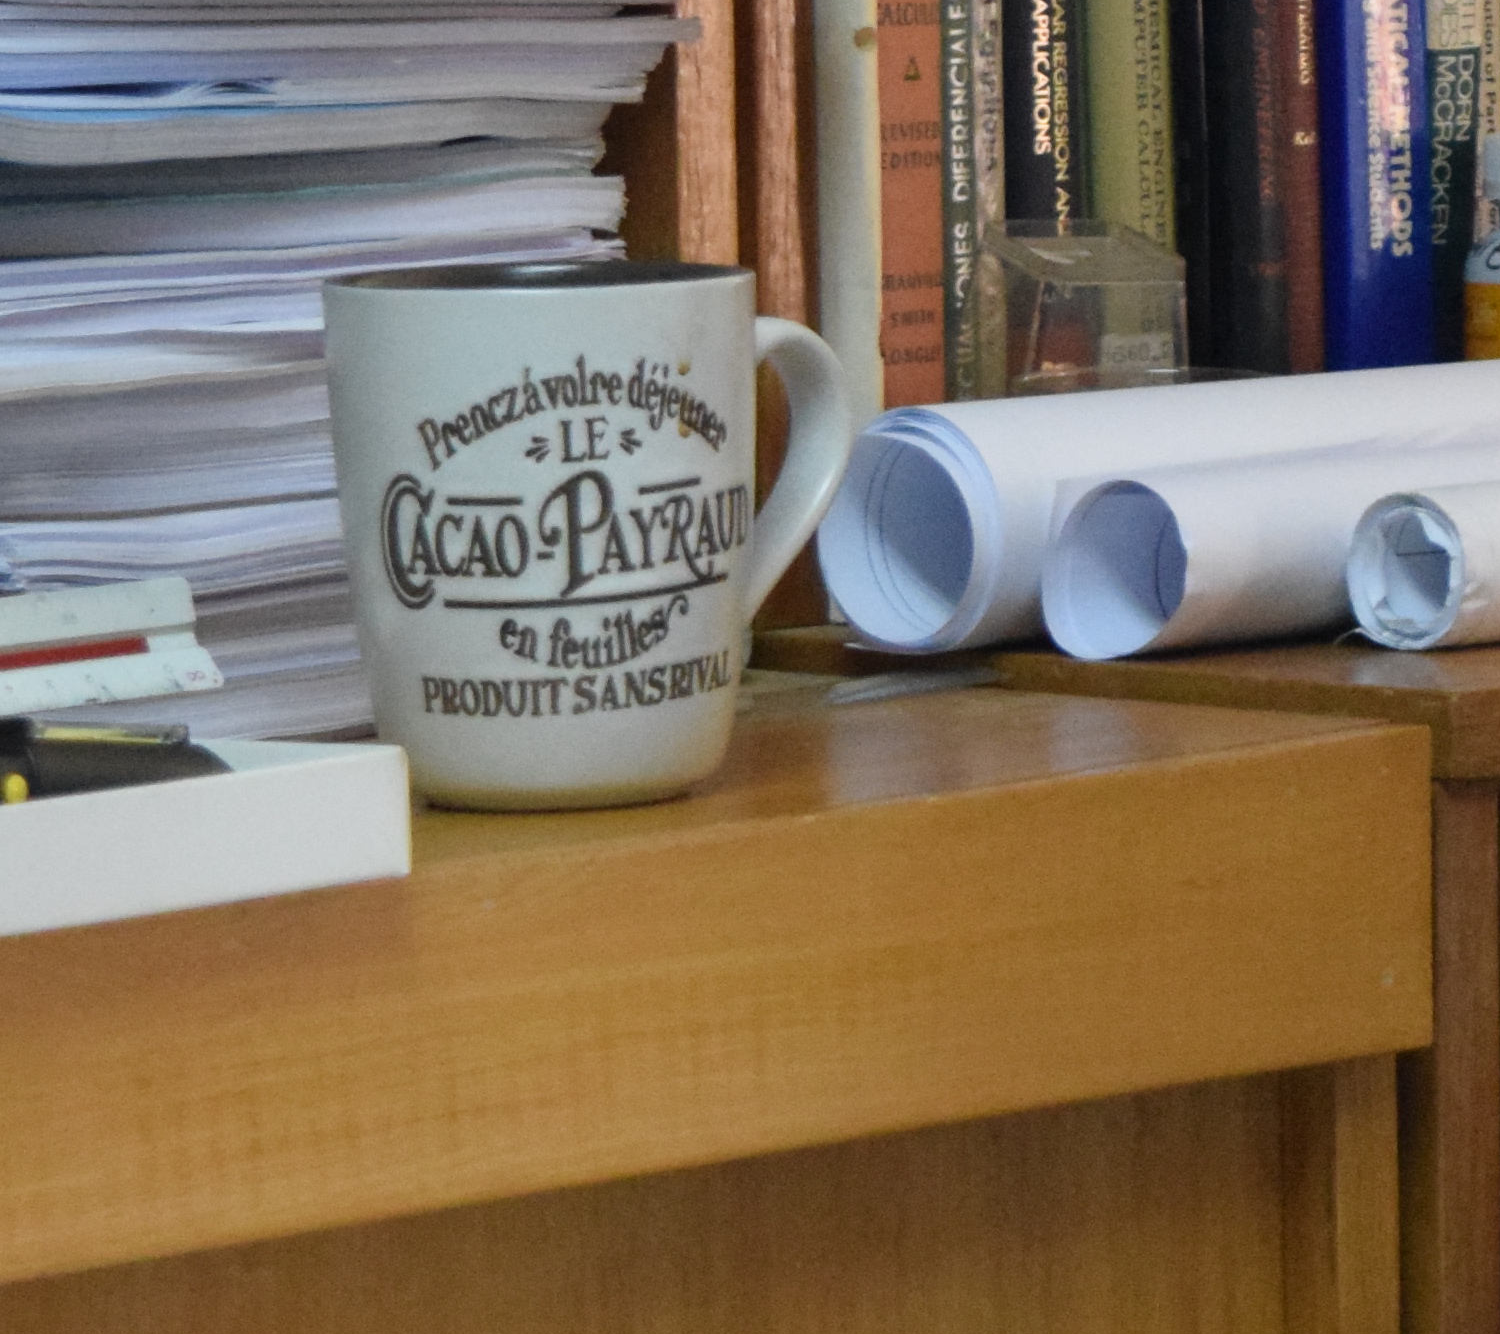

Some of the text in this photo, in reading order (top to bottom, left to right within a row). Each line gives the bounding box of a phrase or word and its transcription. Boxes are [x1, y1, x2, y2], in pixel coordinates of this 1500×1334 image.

[1052, 40, 1072, 182] REGRESSION
[1455, 52, 1476, 142] DORN
[1138, 119, 1157, 237] CALCUL
[1389, 97, 1413, 258] METHODS
[1430, 54, 1458, 245] McCRACKEN
[560, 415, 611, 464] LE
[627, 357, 729, 454] déjeuner
[498, 591, 691, 669] en feuilles
[422, 649, 732, 718] PRODUIT SANS RIVAL
